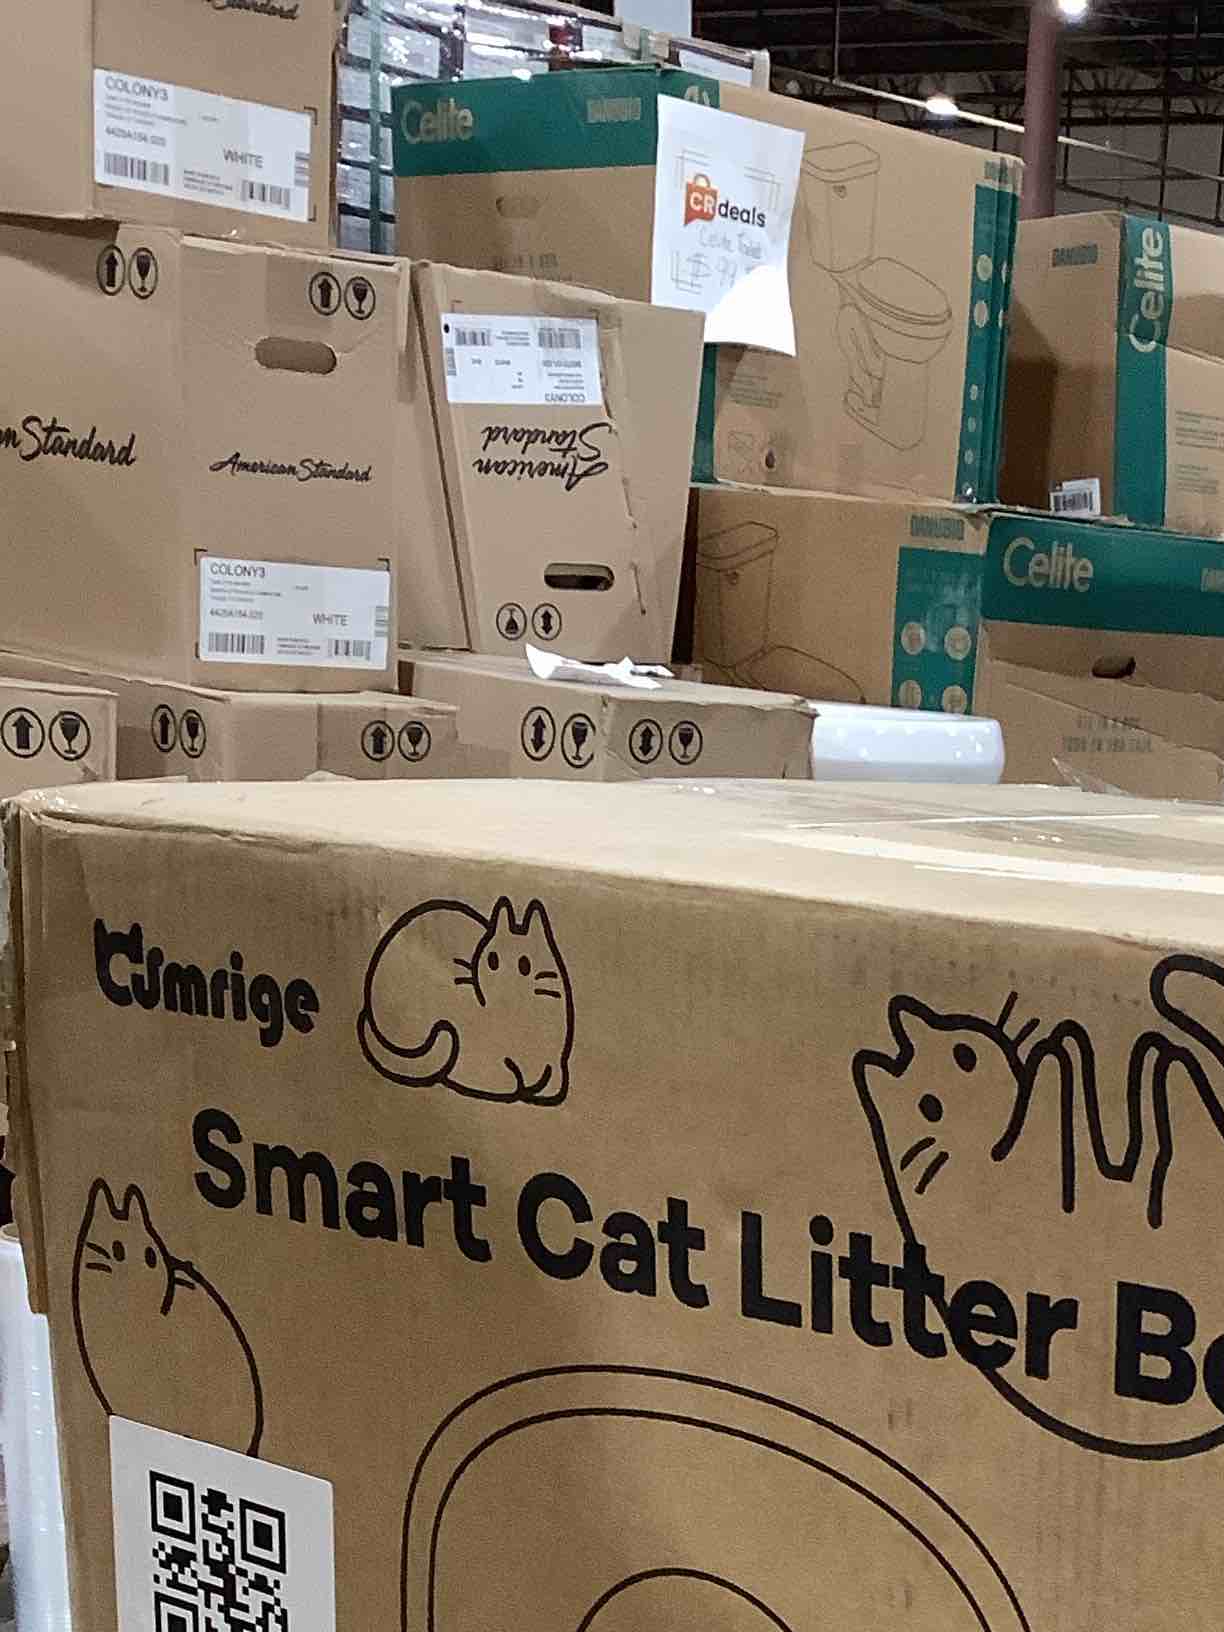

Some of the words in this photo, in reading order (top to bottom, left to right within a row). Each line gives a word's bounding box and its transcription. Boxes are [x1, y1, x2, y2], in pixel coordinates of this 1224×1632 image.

[105, 76, 168, 100] COLONY3
[402, 98, 474, 144] Celite
[223, 149, 264, 168] WHITE
[718, 199, 766, 228] deals
[1129, 226, 1165, 352] Celite
[20, 415, 137, 467] Standard
[481, 422, 613, 462] Standard
[473, 457, 609, 491] American
[210, 563, 266, 577] COLONY3
[1003, 537, 1094, 592] Celite
[313, 613, 349, 626] WHITE
[192, 1108, 493, 1263] Smart
[517, 1171, 711, 1310] Cat
[741, 1210, 1079, 1382] Litter
